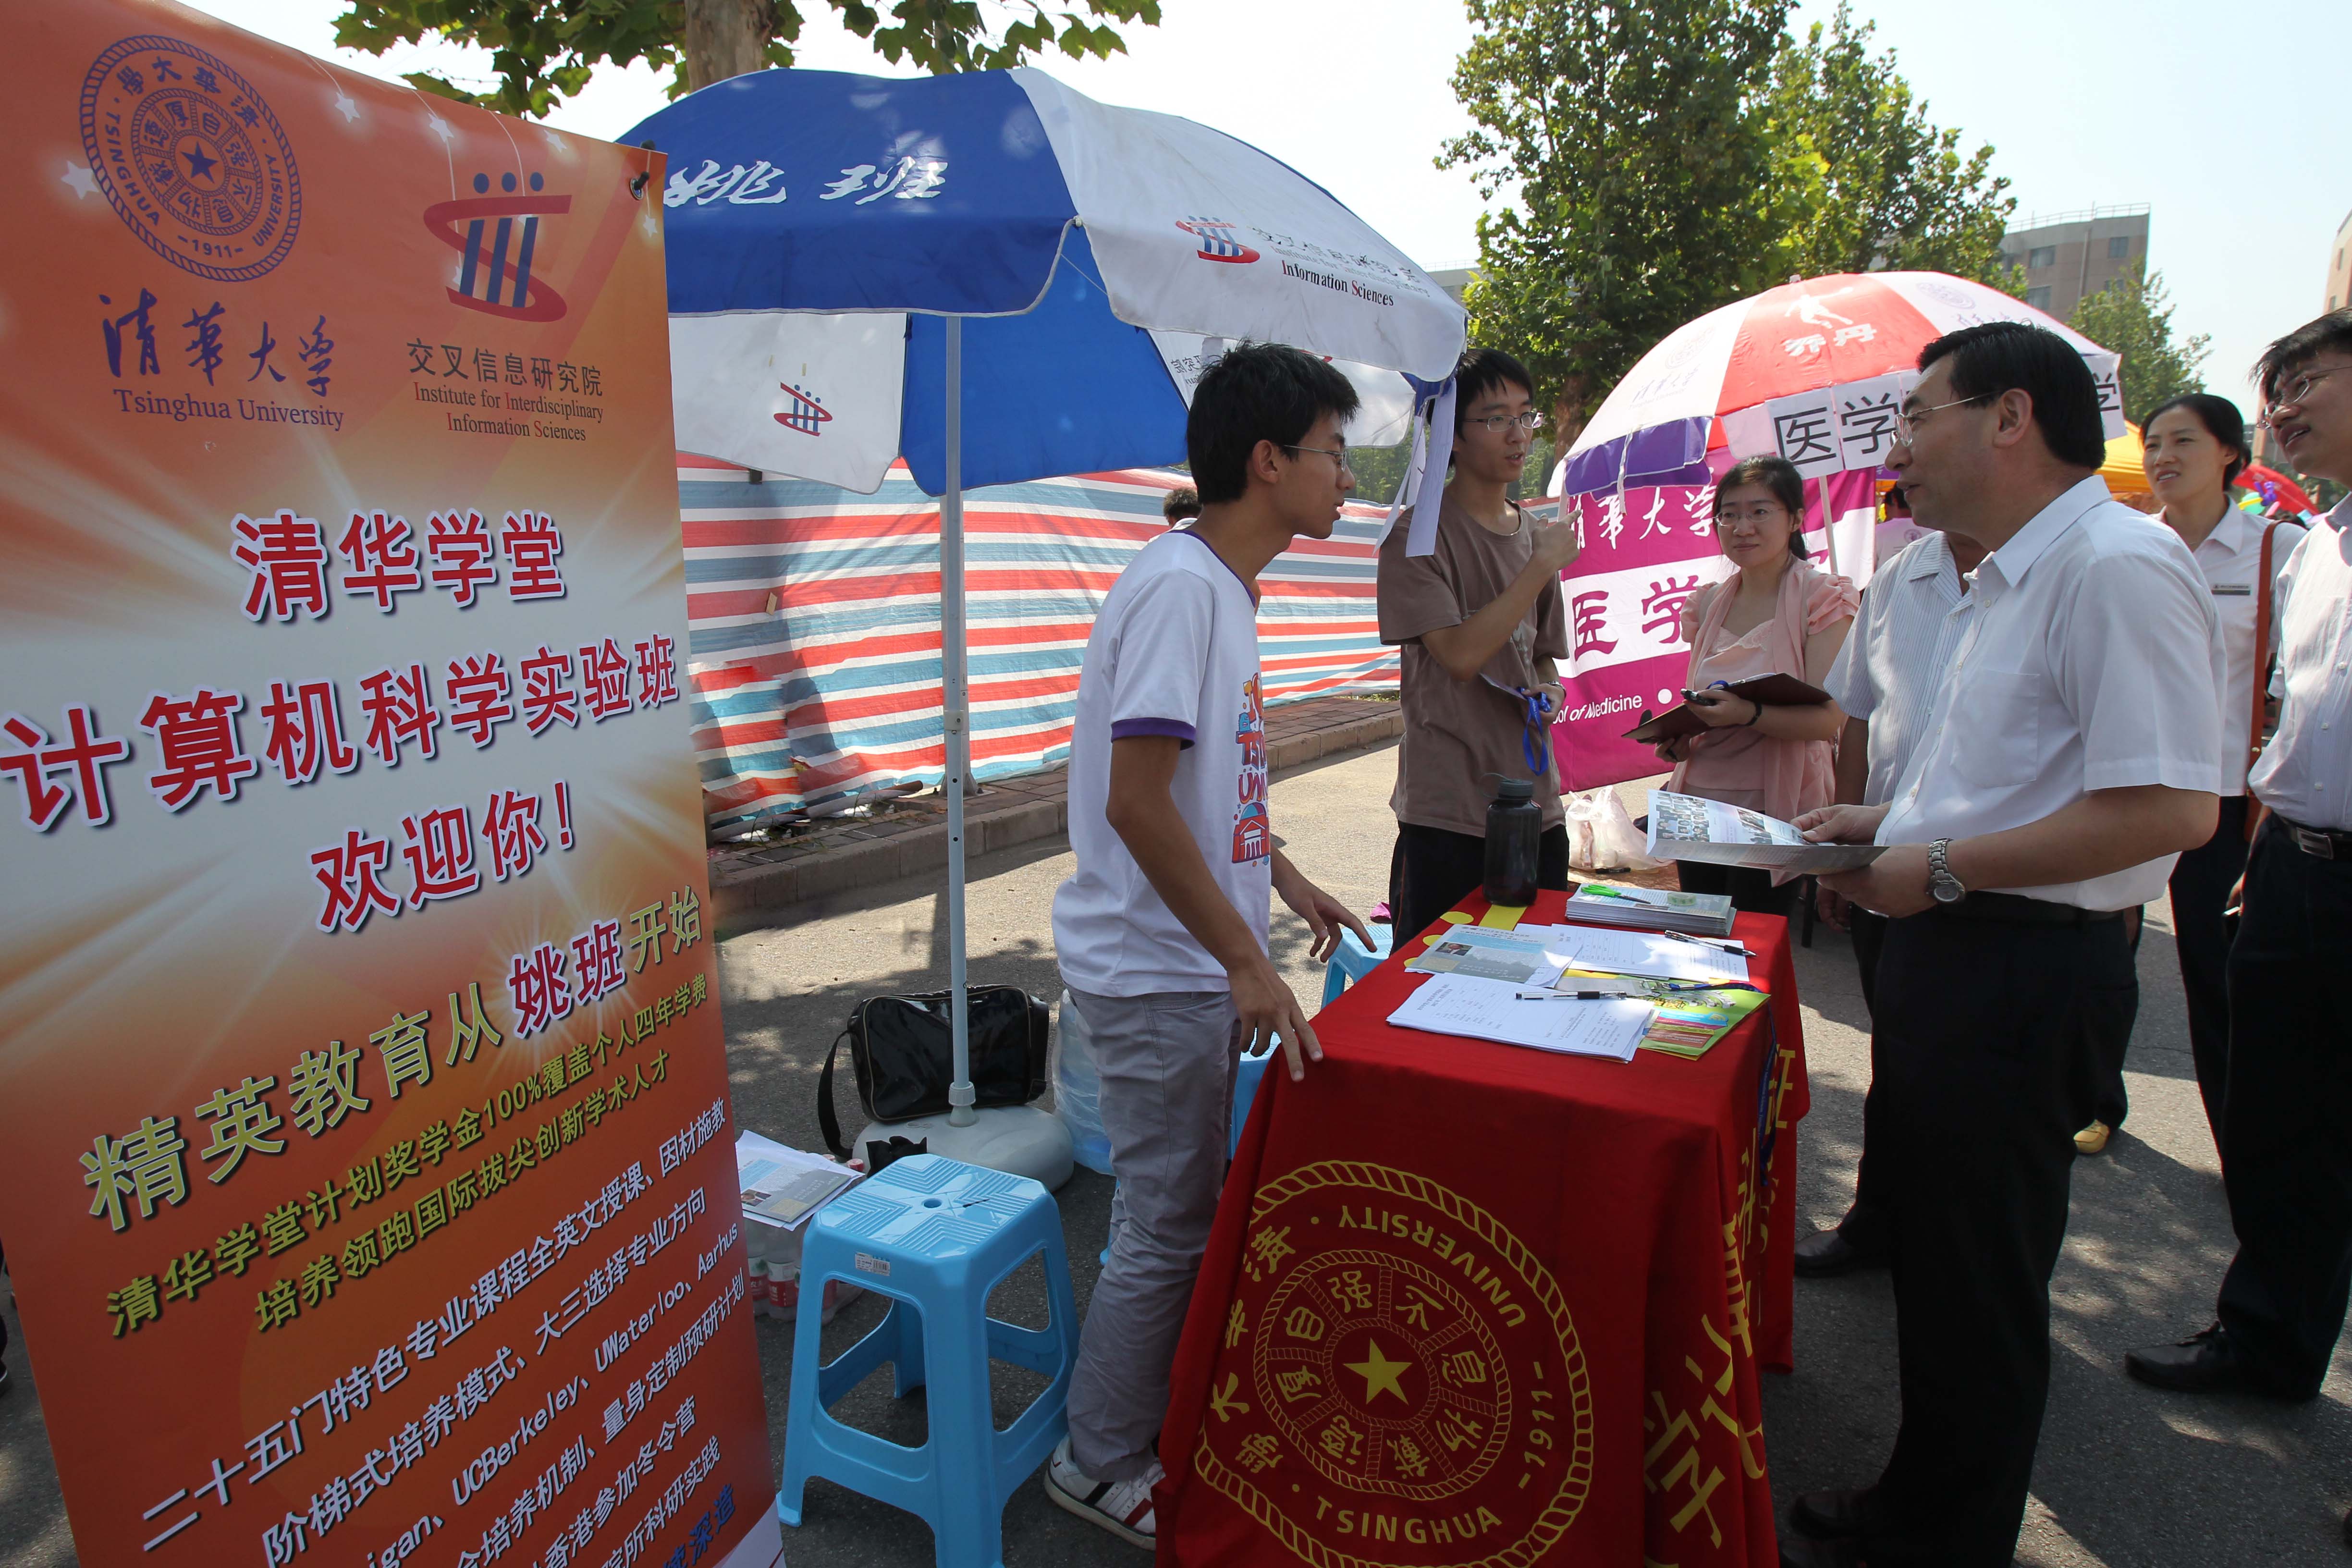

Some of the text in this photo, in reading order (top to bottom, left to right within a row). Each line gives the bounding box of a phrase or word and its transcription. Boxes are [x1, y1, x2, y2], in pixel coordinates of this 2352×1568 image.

[106, 111, 283, 246] TSINGHUA UNIVERSITY
[1282, 260, 1394, 306] Information Sciences
[113, 388, 344, 431] Tsinghua University
[407, 338, 602, 396] 交叉信息研究院
[413, 382, 603, 423] Institute for Interdisciplinary
[446, 412, 586, 441] Information Sciences
[232, 508, 566, 621] 清华学堂
[0, 633, 679, 831] 计算机科学实验班
[1569, 704, 1587, 721] of
[1585, 695, 1642, 719] Medicine
[79, 885, 703, 1231] 精英教育从姚班开始
[107, 973, 707, 1336] 清华学堂计划奖学金100%覆盖个人四年学费
[255, 1049, 669, 1331] 培养领跑国际拔尖创新学术人才
[698, 1222, 738, 1280] Aarhus
[1338, 1205, 1526, 1328] UNIVERSITY
[143, 1097, 726, 1552] 二十五门特色专业课程全英文授课、因材施教
[262, 1186, 706, 1568] 阶梯式培养模式、大三选择专业方向
[532, 1396, 696, 1568] 香港参加冬令营
[1315, 1495, 1503, 1543] TSINGHUA
